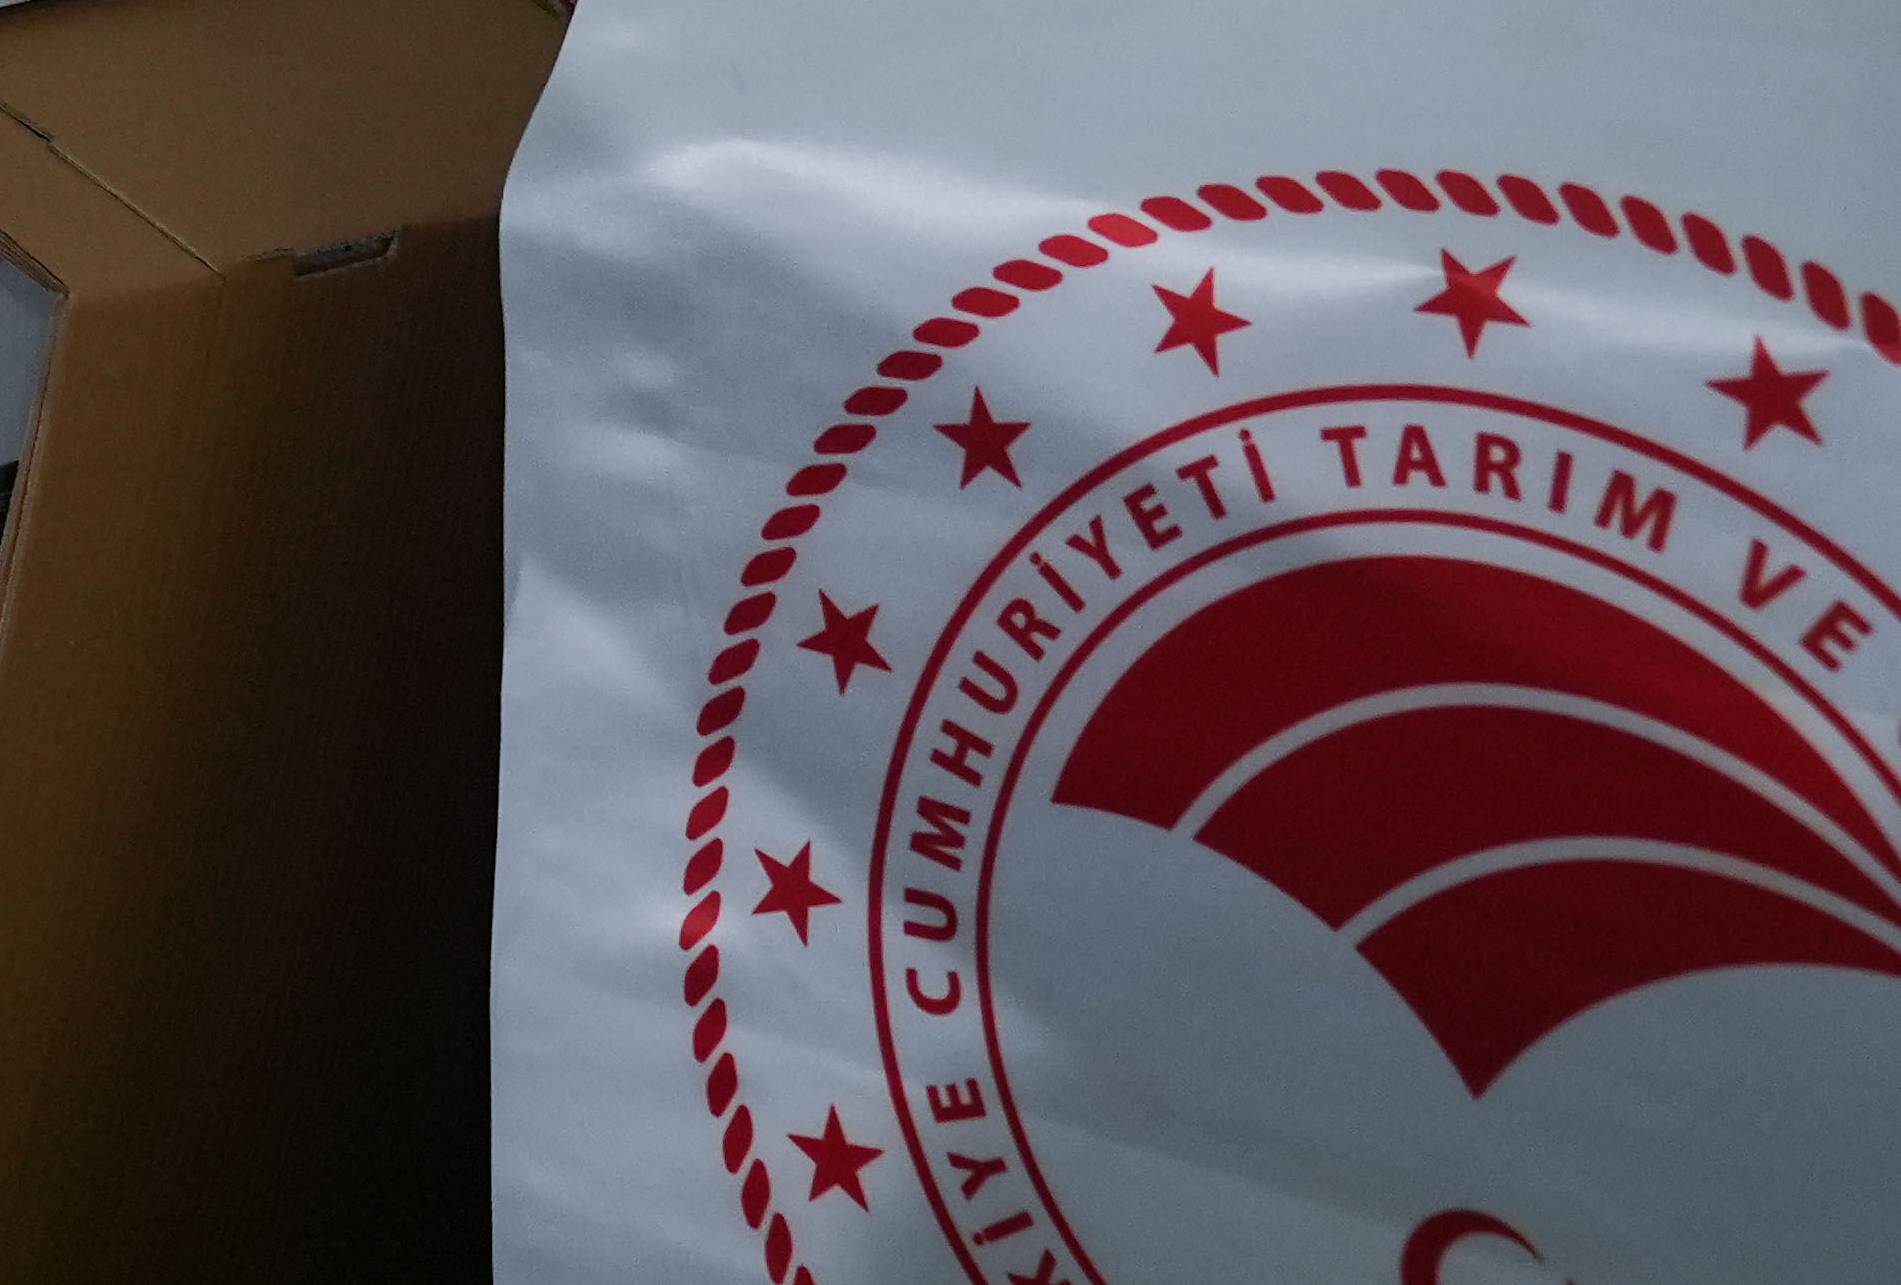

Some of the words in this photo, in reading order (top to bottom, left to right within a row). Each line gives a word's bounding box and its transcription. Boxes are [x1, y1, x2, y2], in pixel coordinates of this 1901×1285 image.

[903, 428, 1277, 1016] CUMHURİYETİ
[1321, 423, 1677, 552] TARIM
[1740, 538, 1874, 672] VE
